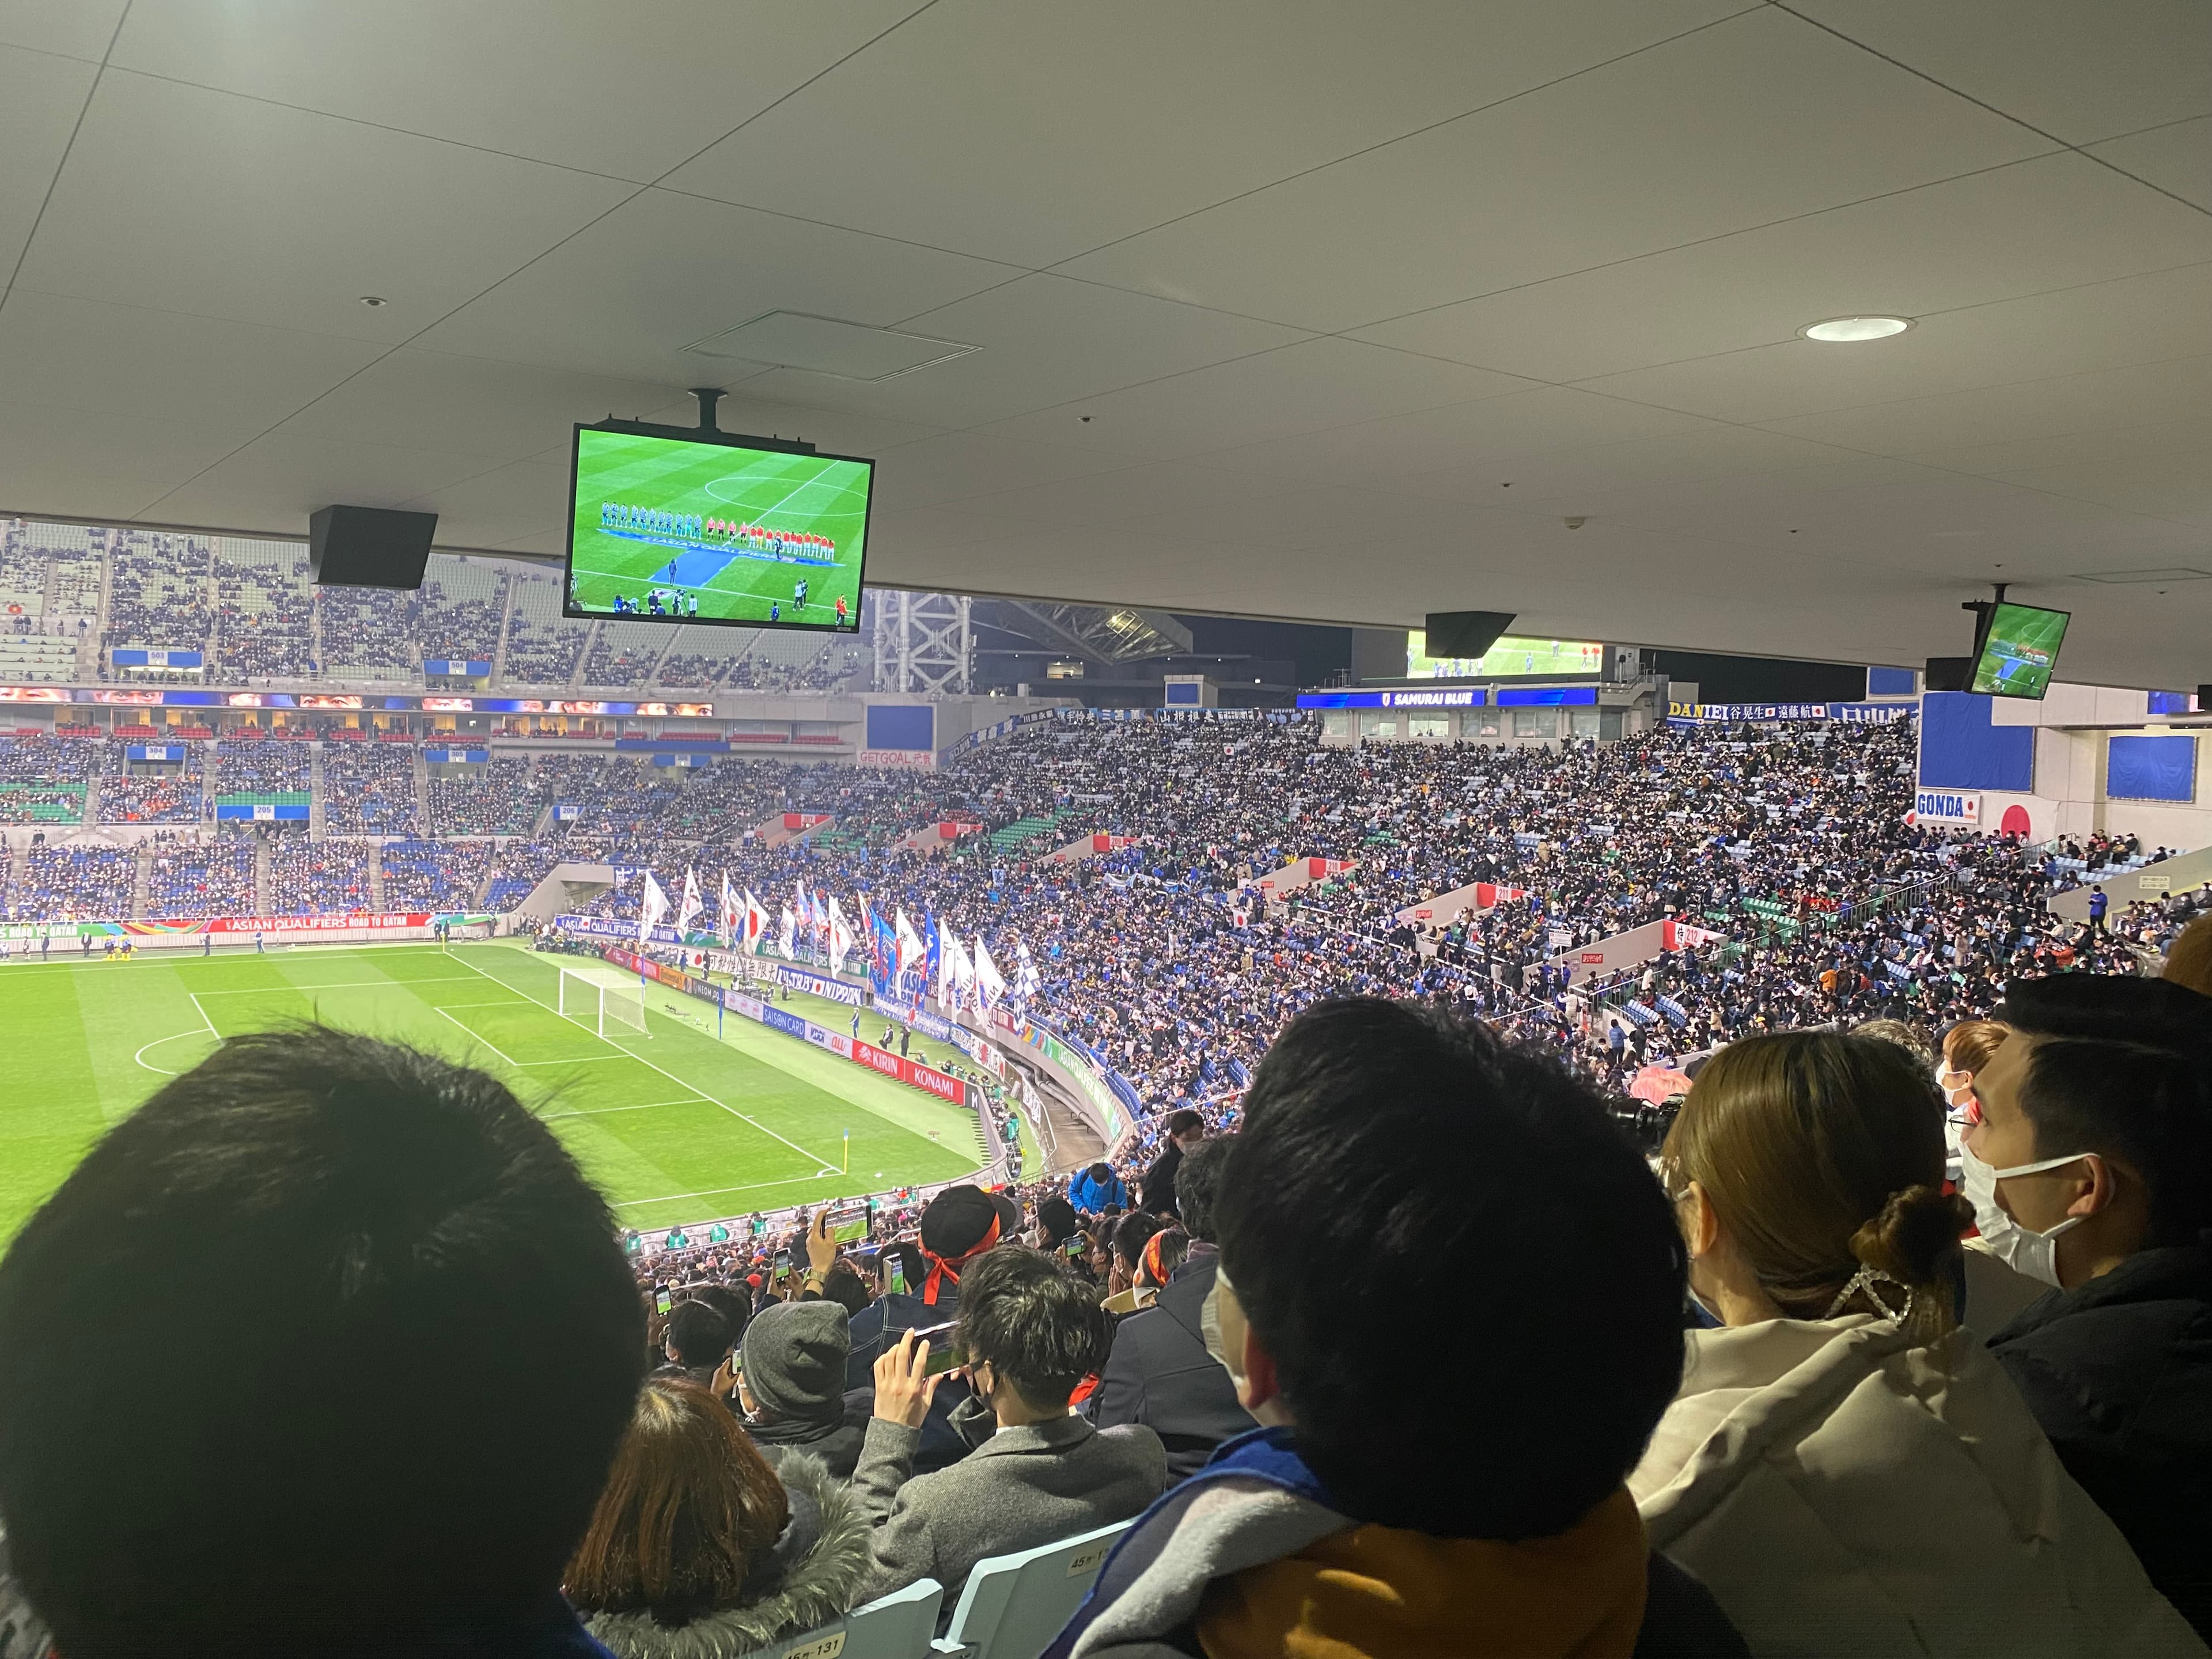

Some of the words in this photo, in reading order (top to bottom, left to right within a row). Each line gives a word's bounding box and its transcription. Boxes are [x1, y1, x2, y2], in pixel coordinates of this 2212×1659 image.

[1395, 694, 1443, 705] SAMURAI
[1445, 692, 1473, 704] BLUE
[1730, 706, 1764, 719] 谷晃生
[1778, 704, 1811, 719] 遠藤航
[912, 753, 931, 766] 元気
[1918, 794, 1964, 817] GONDA
[1328, 862, 1338, 870] 210
[1498, 888, 1508, 899] 211
[232, 921, 272, 930] ASIAN
[274, 917, 347, 930] QUALIFIERS
[349, 917, 369, 927] ROAD
[371, 917, 381, 927] TO
[382, 916, 407, 927] QATAR
[9, 927, 33, 937] ROAD
[49, 925, 78, 937] QATAR
[591, 922, 637, 937] QUALIFIERS
[659, 930, 675, 941] QATAR
[1687, 928, 1698, 943] 212
[698, 984, 711, 997] NEOM
[824, 981, 862, 1007] NIPPON
[764, 1009, 787, 1027] SAISON
[787, 1018, 805, 1035] CARD
[810, 1027, 825, 1044] KDDI
[831, 1036, 846, 1051] au
[873, 1050, 898, 1075] KIRIN
[915, 1067, 953, 1097] KONAMI
